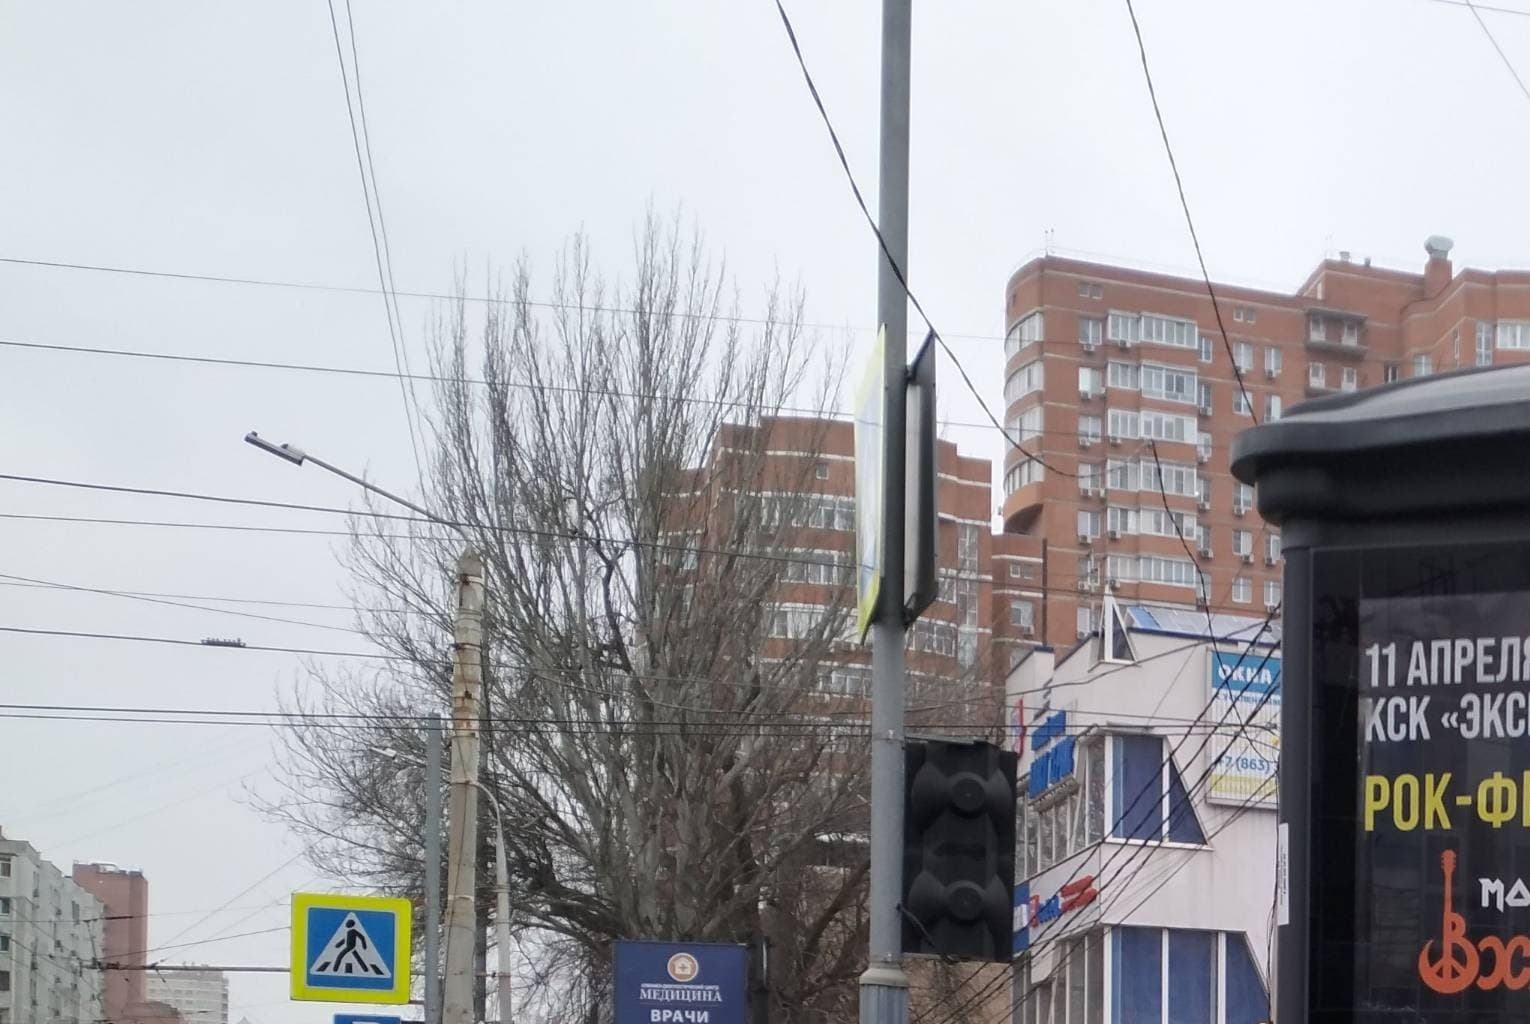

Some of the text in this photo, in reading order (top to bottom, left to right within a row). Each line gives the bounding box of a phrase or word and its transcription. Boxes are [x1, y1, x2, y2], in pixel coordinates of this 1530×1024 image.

[1365, 641, 1397, 687] 11
[1218, 664, 1272, 685] ОКНА
[1364, 696, 1431, 742] КСК
[1236, 757, 1271, 774] (863)
[640, 989, 722, 1002] МЕДИЦИНА
[650, 1009, 709, 1023] ВРАЧИ
